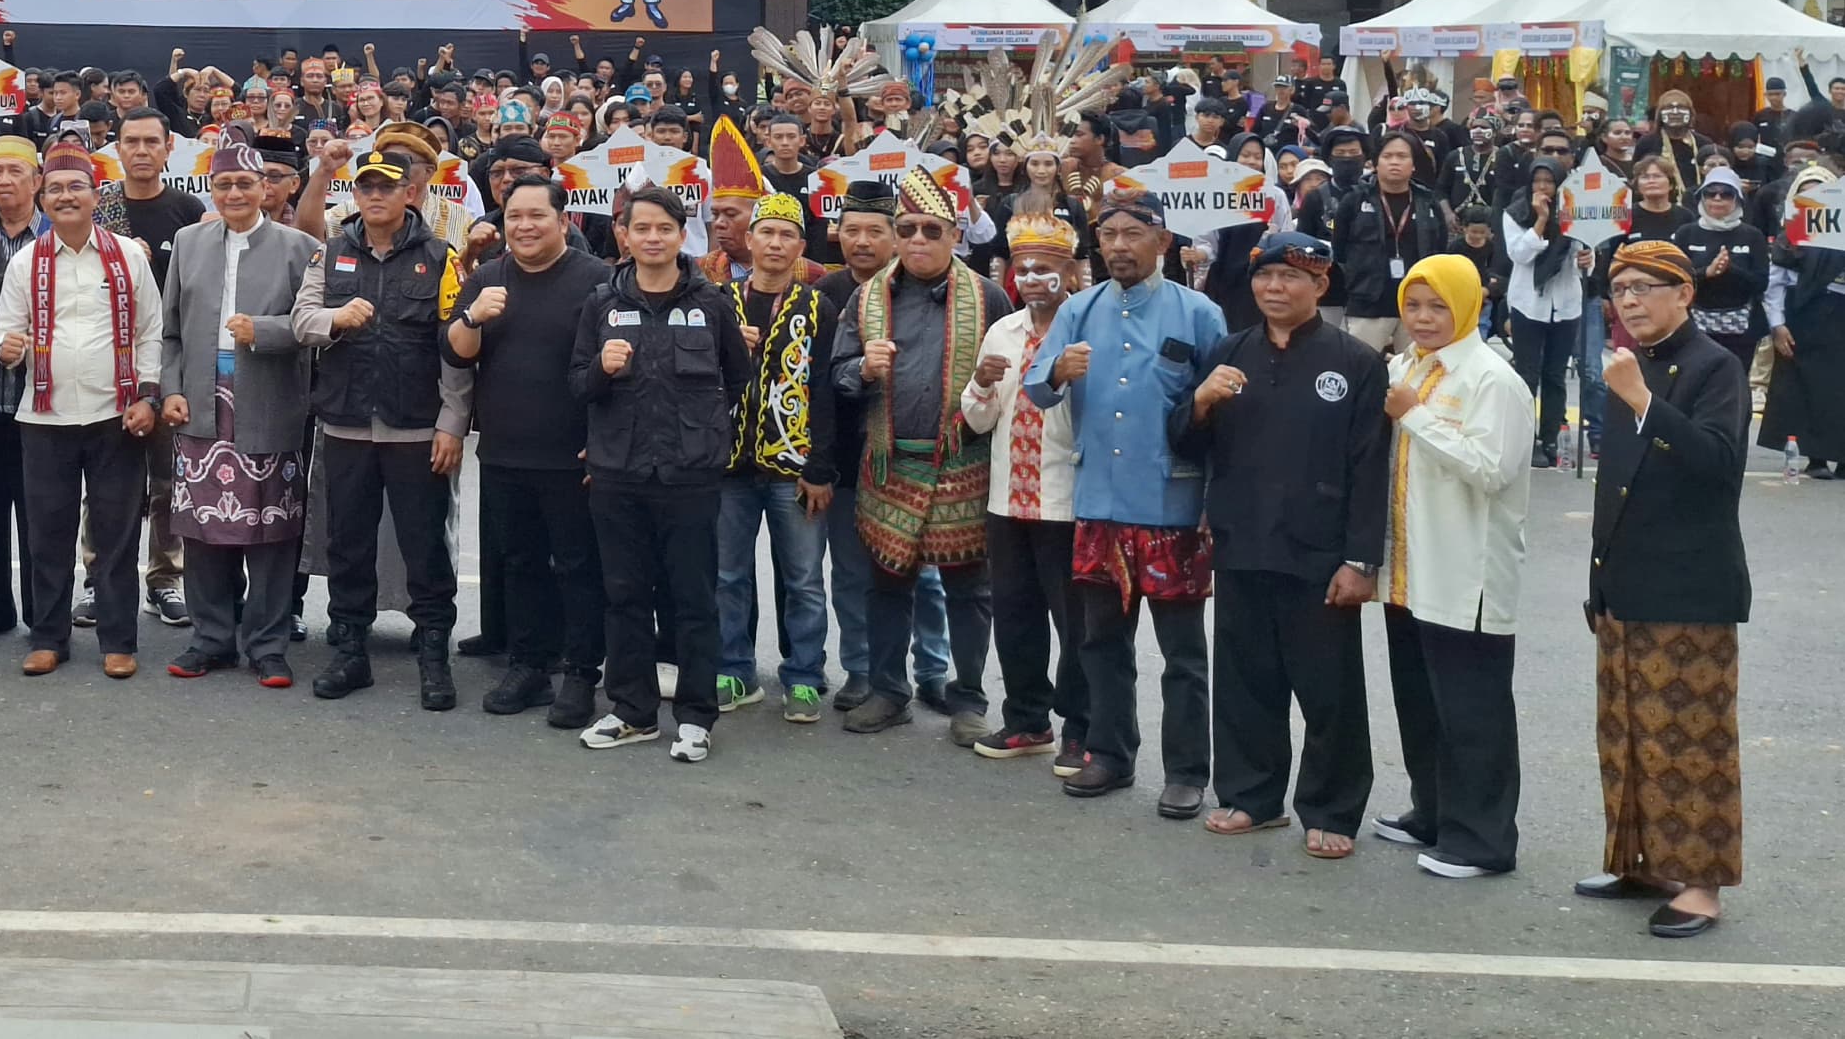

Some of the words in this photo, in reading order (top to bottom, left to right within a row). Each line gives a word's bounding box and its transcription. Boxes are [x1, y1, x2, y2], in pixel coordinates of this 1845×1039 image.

[1161, 192, 1206, 210] AYAK
[1213, 191, 1264, 210] DEAH
[1806, 209, 1842, 234] KK
[37, 257, 50, 346] HORAS
[109, 262, 130, 345] HORAS
